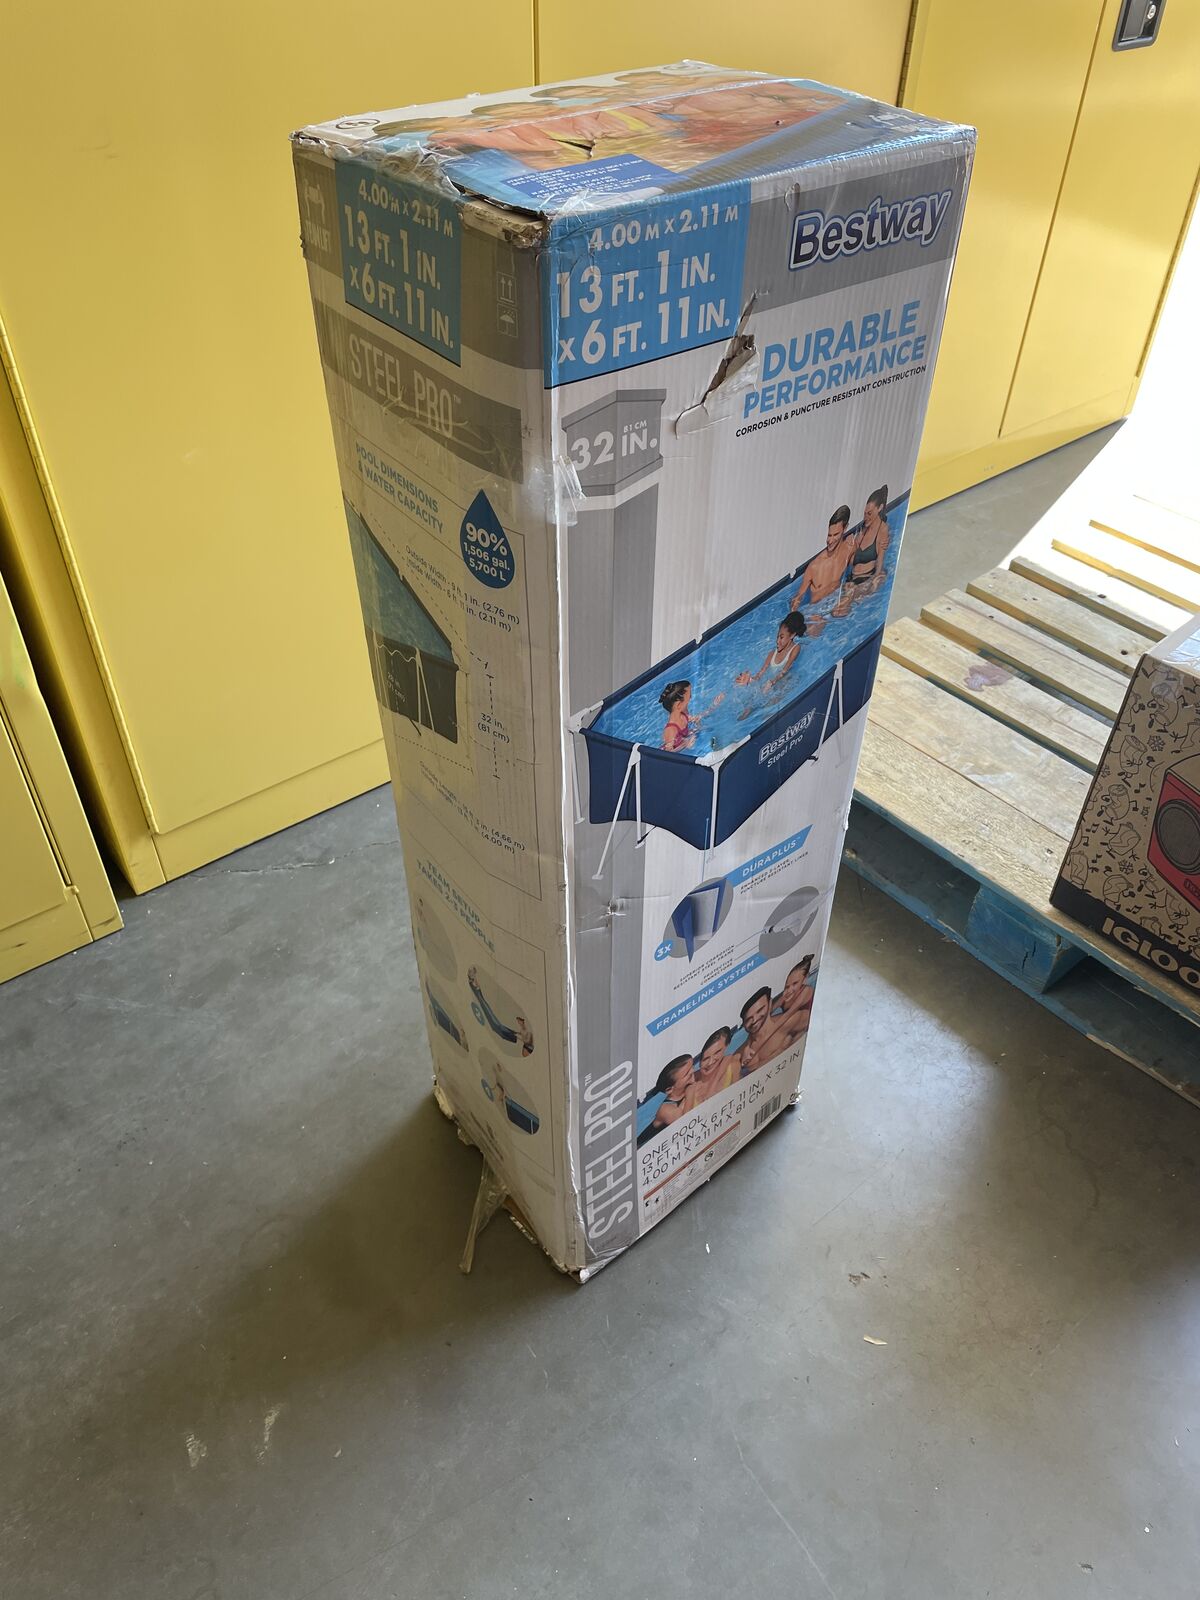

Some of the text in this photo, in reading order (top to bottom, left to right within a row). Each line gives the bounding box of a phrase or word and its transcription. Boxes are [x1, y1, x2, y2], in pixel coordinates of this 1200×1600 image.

[359, 178, 388, 210] 4.00
[412, 199, 439, 231] 2.11
[589, 220, 641, 251] 4.00
[680, 203, 719, 233] 2.11
[788, 190, 952, 272] Bestway
[344, 204, 370, 255] 13
[374, 230, 395, 267] FT.
[416, 250, 440, 290] IN.
[557, 249, 716, 318] 13 FT. 1 IN.
[378, 280, 399, 318] FT.
[404, 281, 425, 332] 11
[431, 308, 454, 348] IN.
[612, 321, 647, 357] FT.
[658, 296, 690, 344] 11
[698, 298, 730, 334] IN.
[762, 300, 920, 383] DURABLE
[350, 334, 454, 439] STEEL PRO
[735, 365, 926, 437] CORROSION & PUNCTURE RESISTANT CONSTRUCTION
[743, 335, 926, 419] PERFORMANCE
[570, 428, 658, 471] 32 IN.
[623, 423, 633, 434] 81
[356, 441, 439, 513] POOL DIMENSIONS
[364, 464, 396, 498] WATER
[398, 490, 443, 534] CAPACITY
[463, 542, 511, 571] 1,506 gal.
[465, 522, 508, 556] 90%
[470, 557, 507, 582] 5,700 L
[479, 611, 497, 626] (2.11
[499, 621, 512, 633] m)
[482, 601, 505, 618] (2.76
[507, 613, 520, 625] m)
[478, 722, 510, 744] (81 cm)
[481, 712, 505, 731] 32 in.
[758, 707, 816, 765] Bestway
[766, 734, 803, 768] Steel Pro
[742, 839, 797, 877] DURAPLUS
[656, 943, 672, 958] 3X
[656, 960, 755, 1030] FRAMELINK SYSTEM
[584, 1060, 633, 1146] PRO
[641, 1162, 653, 1177] 13
[656, 1149, 673, 1166] FT.
[700, 1120, 708, 1131] X
[710, 1112, 718, 1124] 6
[774, 1059, 787, 1075] 32
[642, 1163, 669, 1187] 4.00
[671, 1154, 681, 1165] M
[683, 1145, 692, 1157] X
[694, 1128, 711, 1147] 2.11
[725, 1111, 733, 1121] X
[736, 1099, 746, 1111] 81
[749, 1086, 765, 1104] CM
[642, 1115, 704, 1165] ONE POOL
[584, 1123, 634, 1239] STEEL
